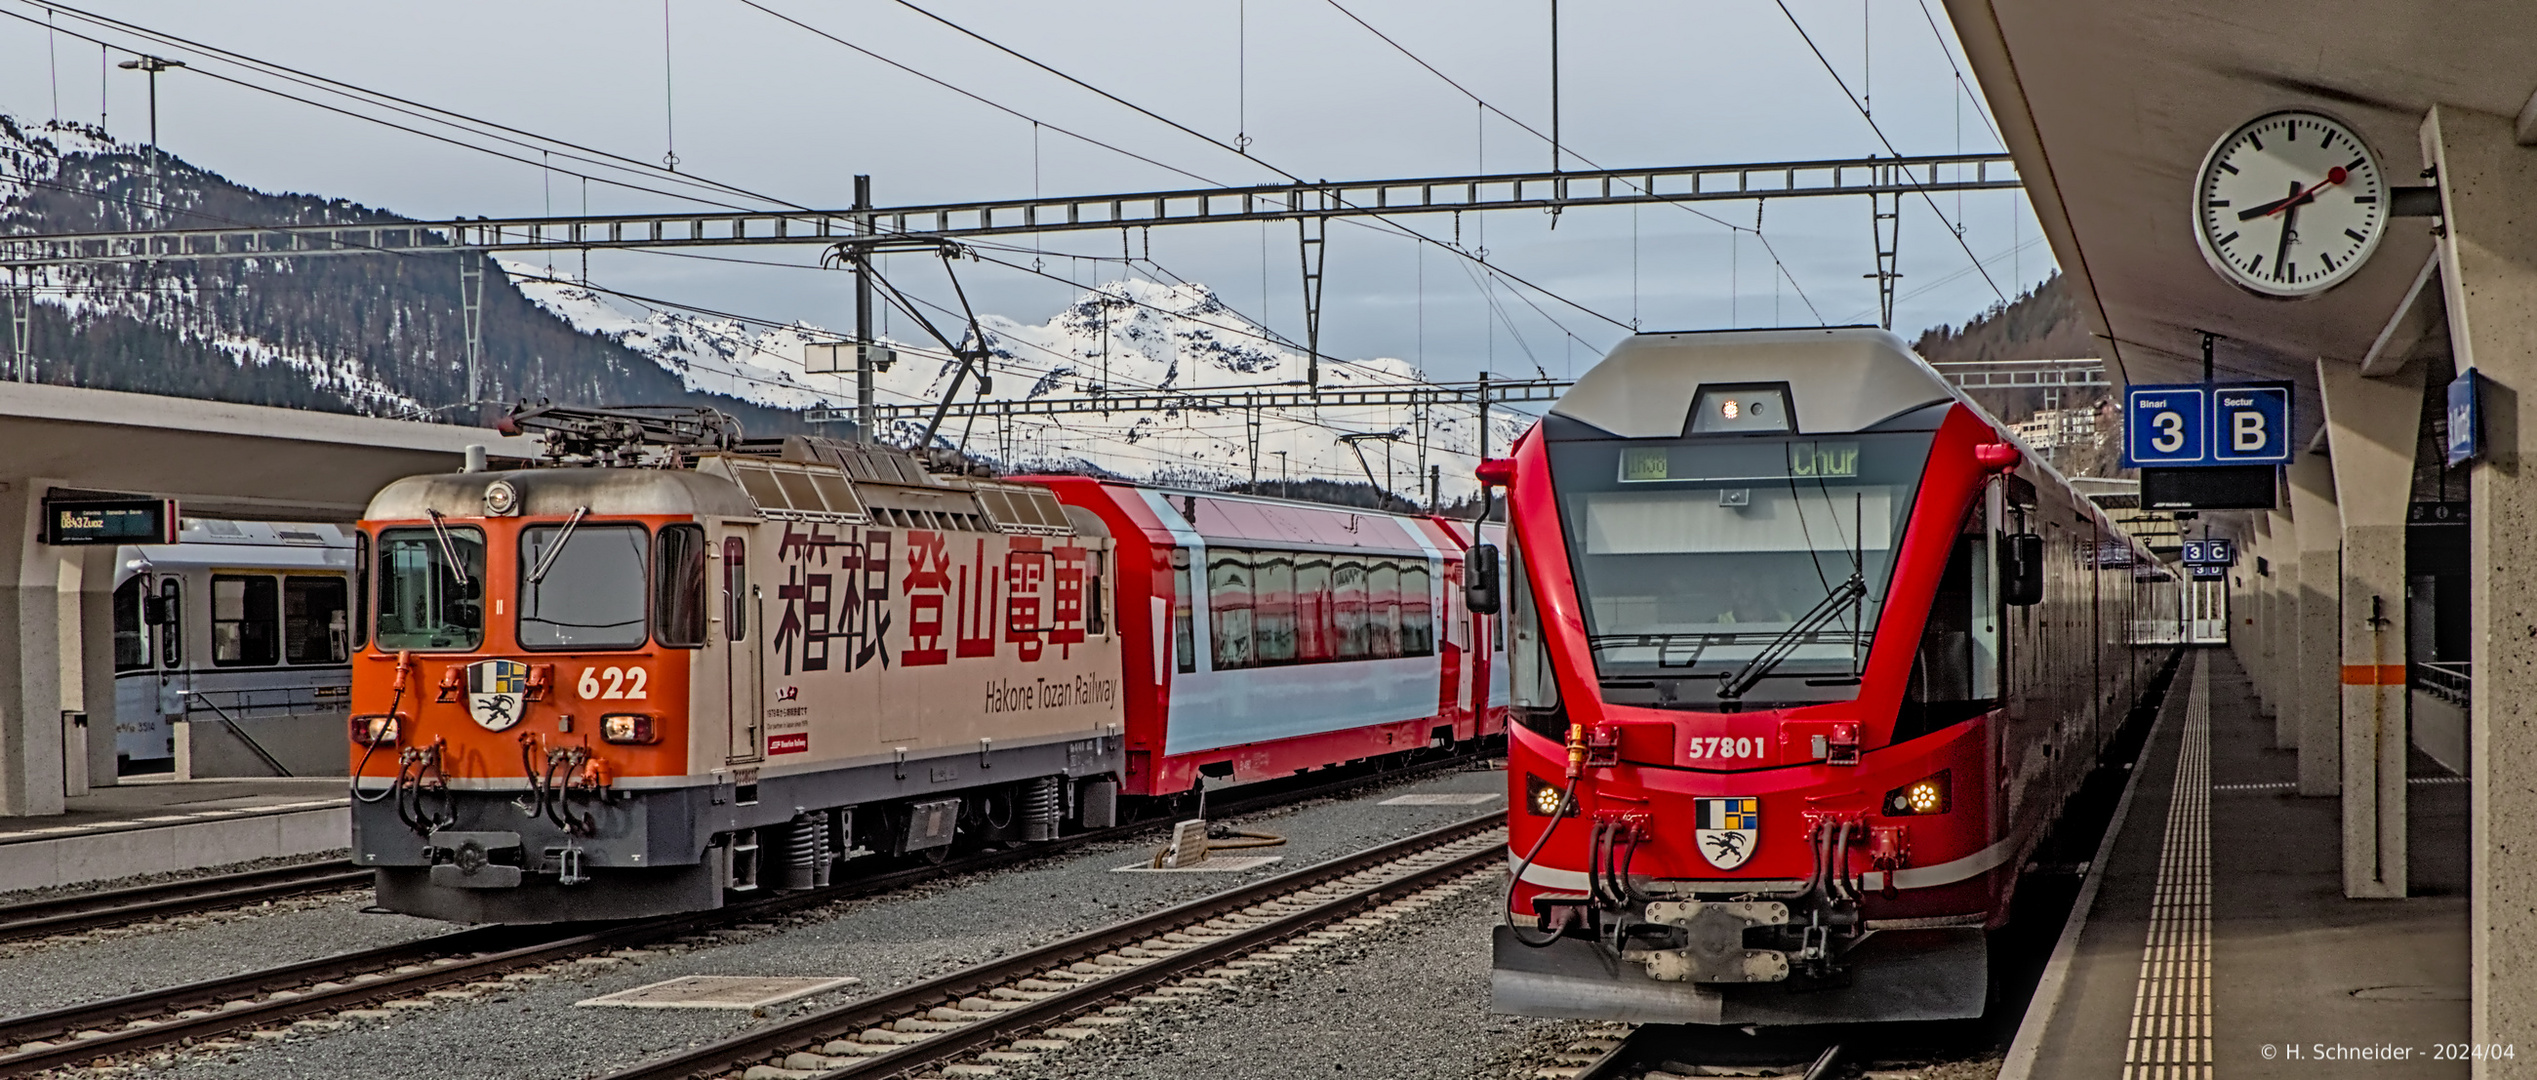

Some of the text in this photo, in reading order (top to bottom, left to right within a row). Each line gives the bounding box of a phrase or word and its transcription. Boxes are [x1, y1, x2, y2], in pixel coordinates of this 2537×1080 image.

[2139, 399, 2167, 408] Binari
[2223, 397, 2254, 407] Sectur
[2151, 411, 2184, 452] 3
[2233, 411, 2267, 451] B
[1793, 444, 1858, 476] Chur
[83, 517, 104, 528] Zuoz
[2190, 546, 2200, 559] 3
[2212, 547, 2224, 559] C
[774, 520, 1087, 676] 箱根登山電車
[577, 666, 648, 700] 622
[985, 671, 1118, 714] Hakone Tozan Railway
[1689, 736, 1765, 759] 57801
